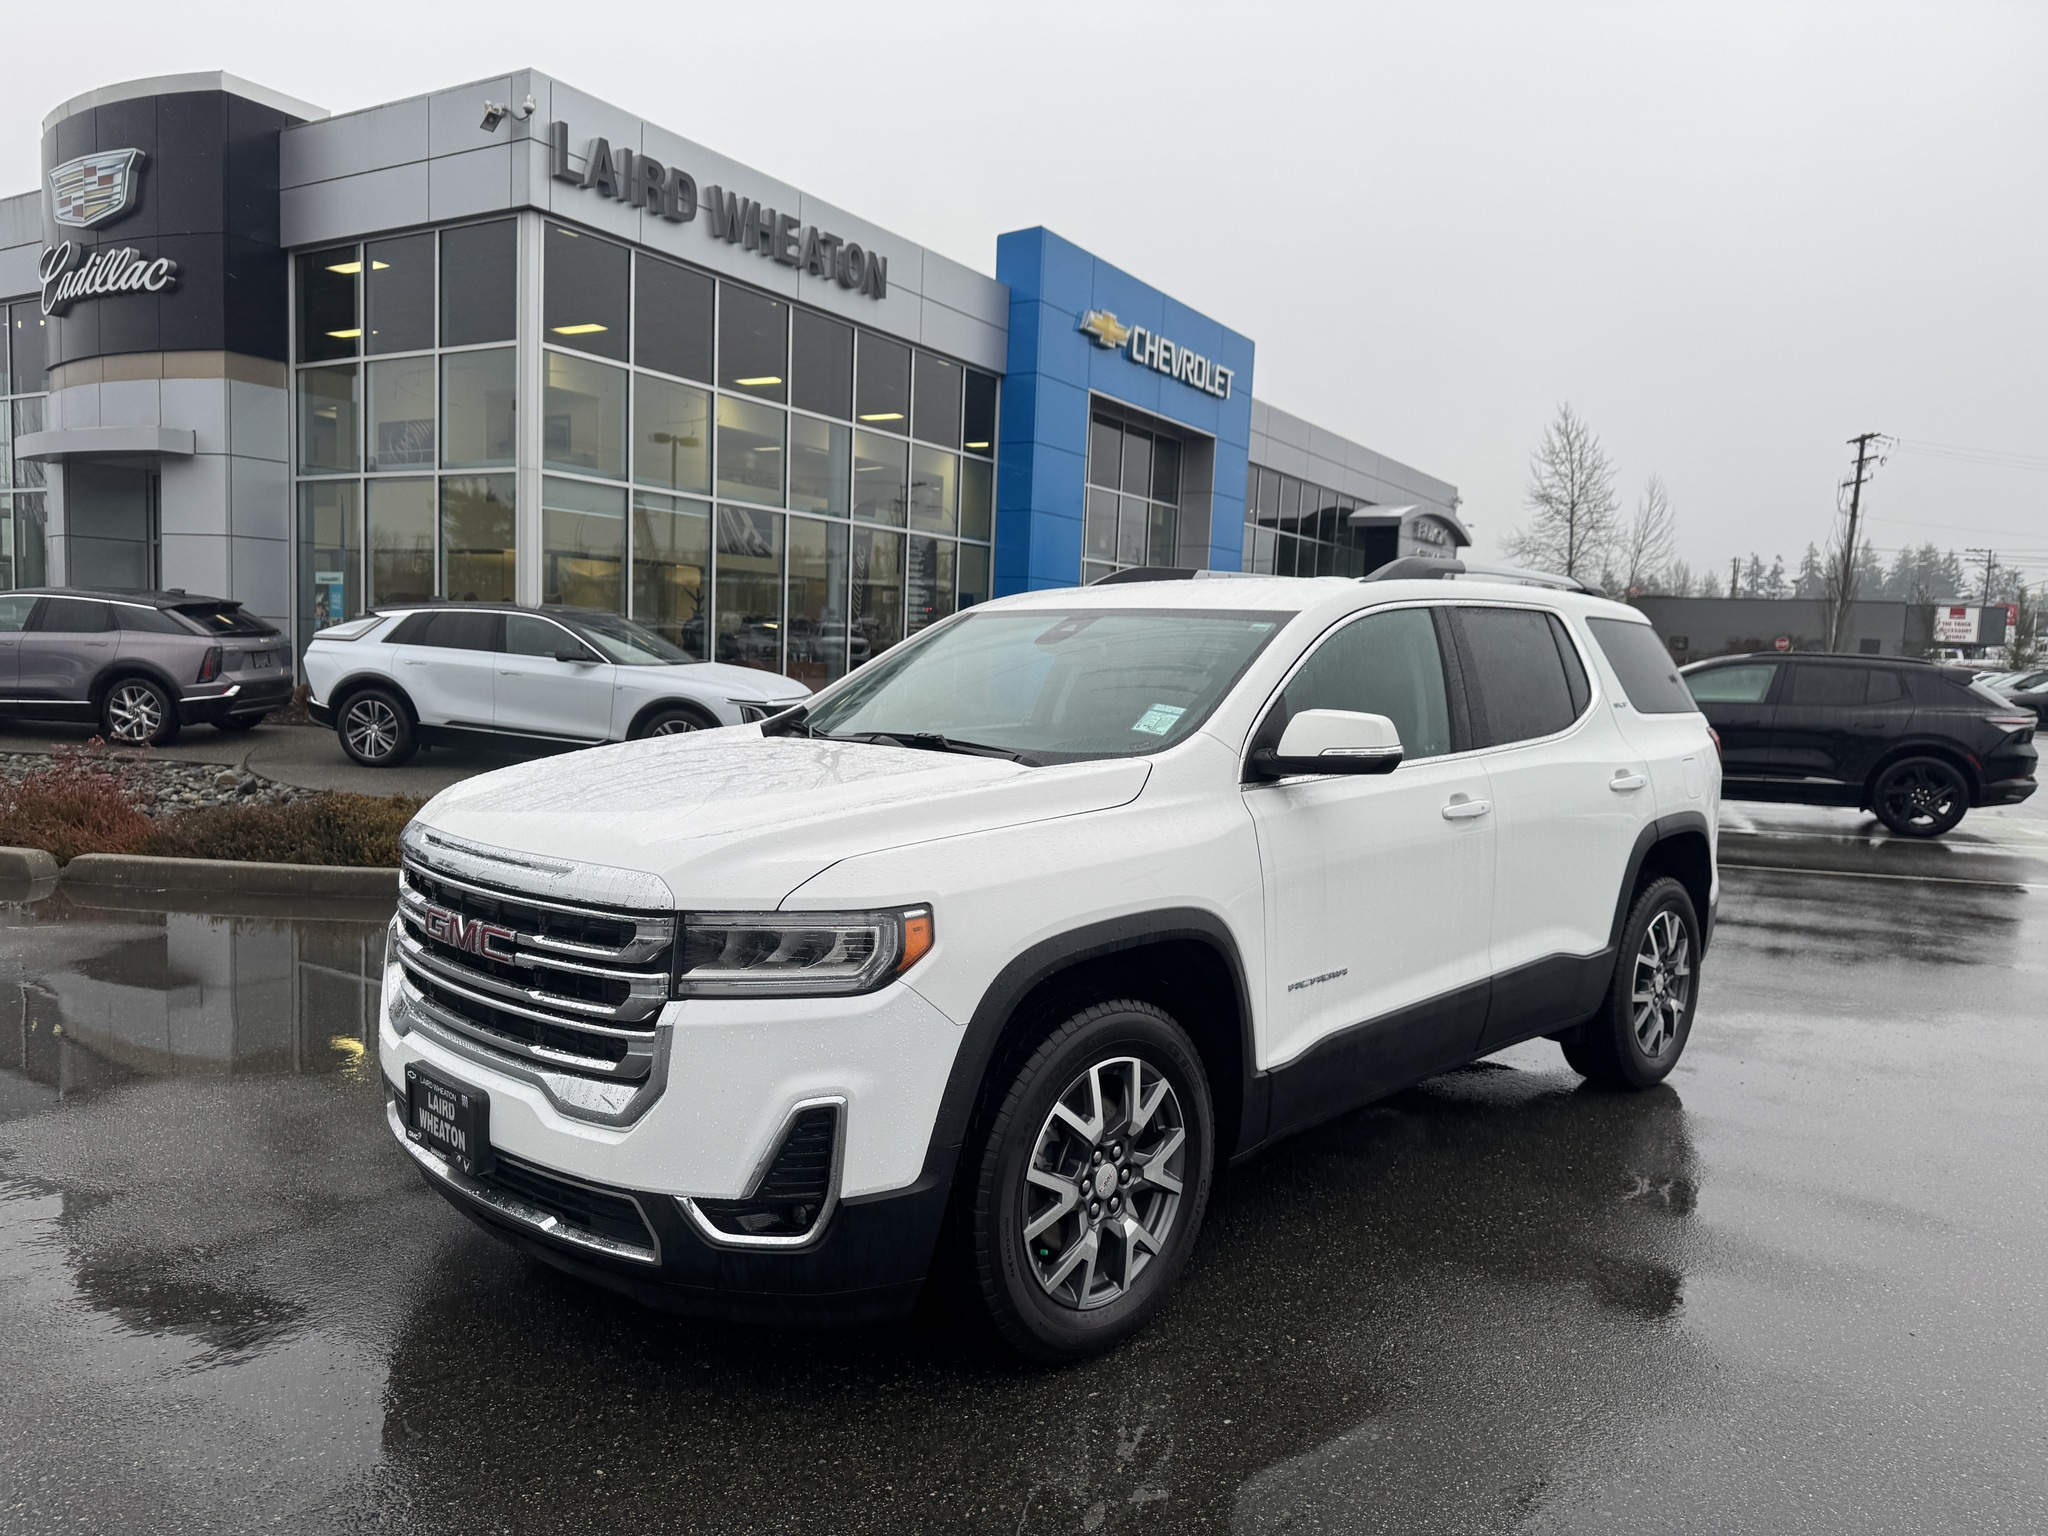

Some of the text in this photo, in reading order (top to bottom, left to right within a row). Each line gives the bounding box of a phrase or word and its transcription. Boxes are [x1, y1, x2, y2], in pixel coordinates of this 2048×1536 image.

[552, 120, 888, 300] LAIRD WHEATON
[38, 239, 172, 316] Cadillac
[1130, 324, 1235, 400] CHEVROLET
[425, 904, 516, 966] GMC
[418, 1106, 466, 1152] WHEATON
[427, 1091, 456, 1121] LAIRD
